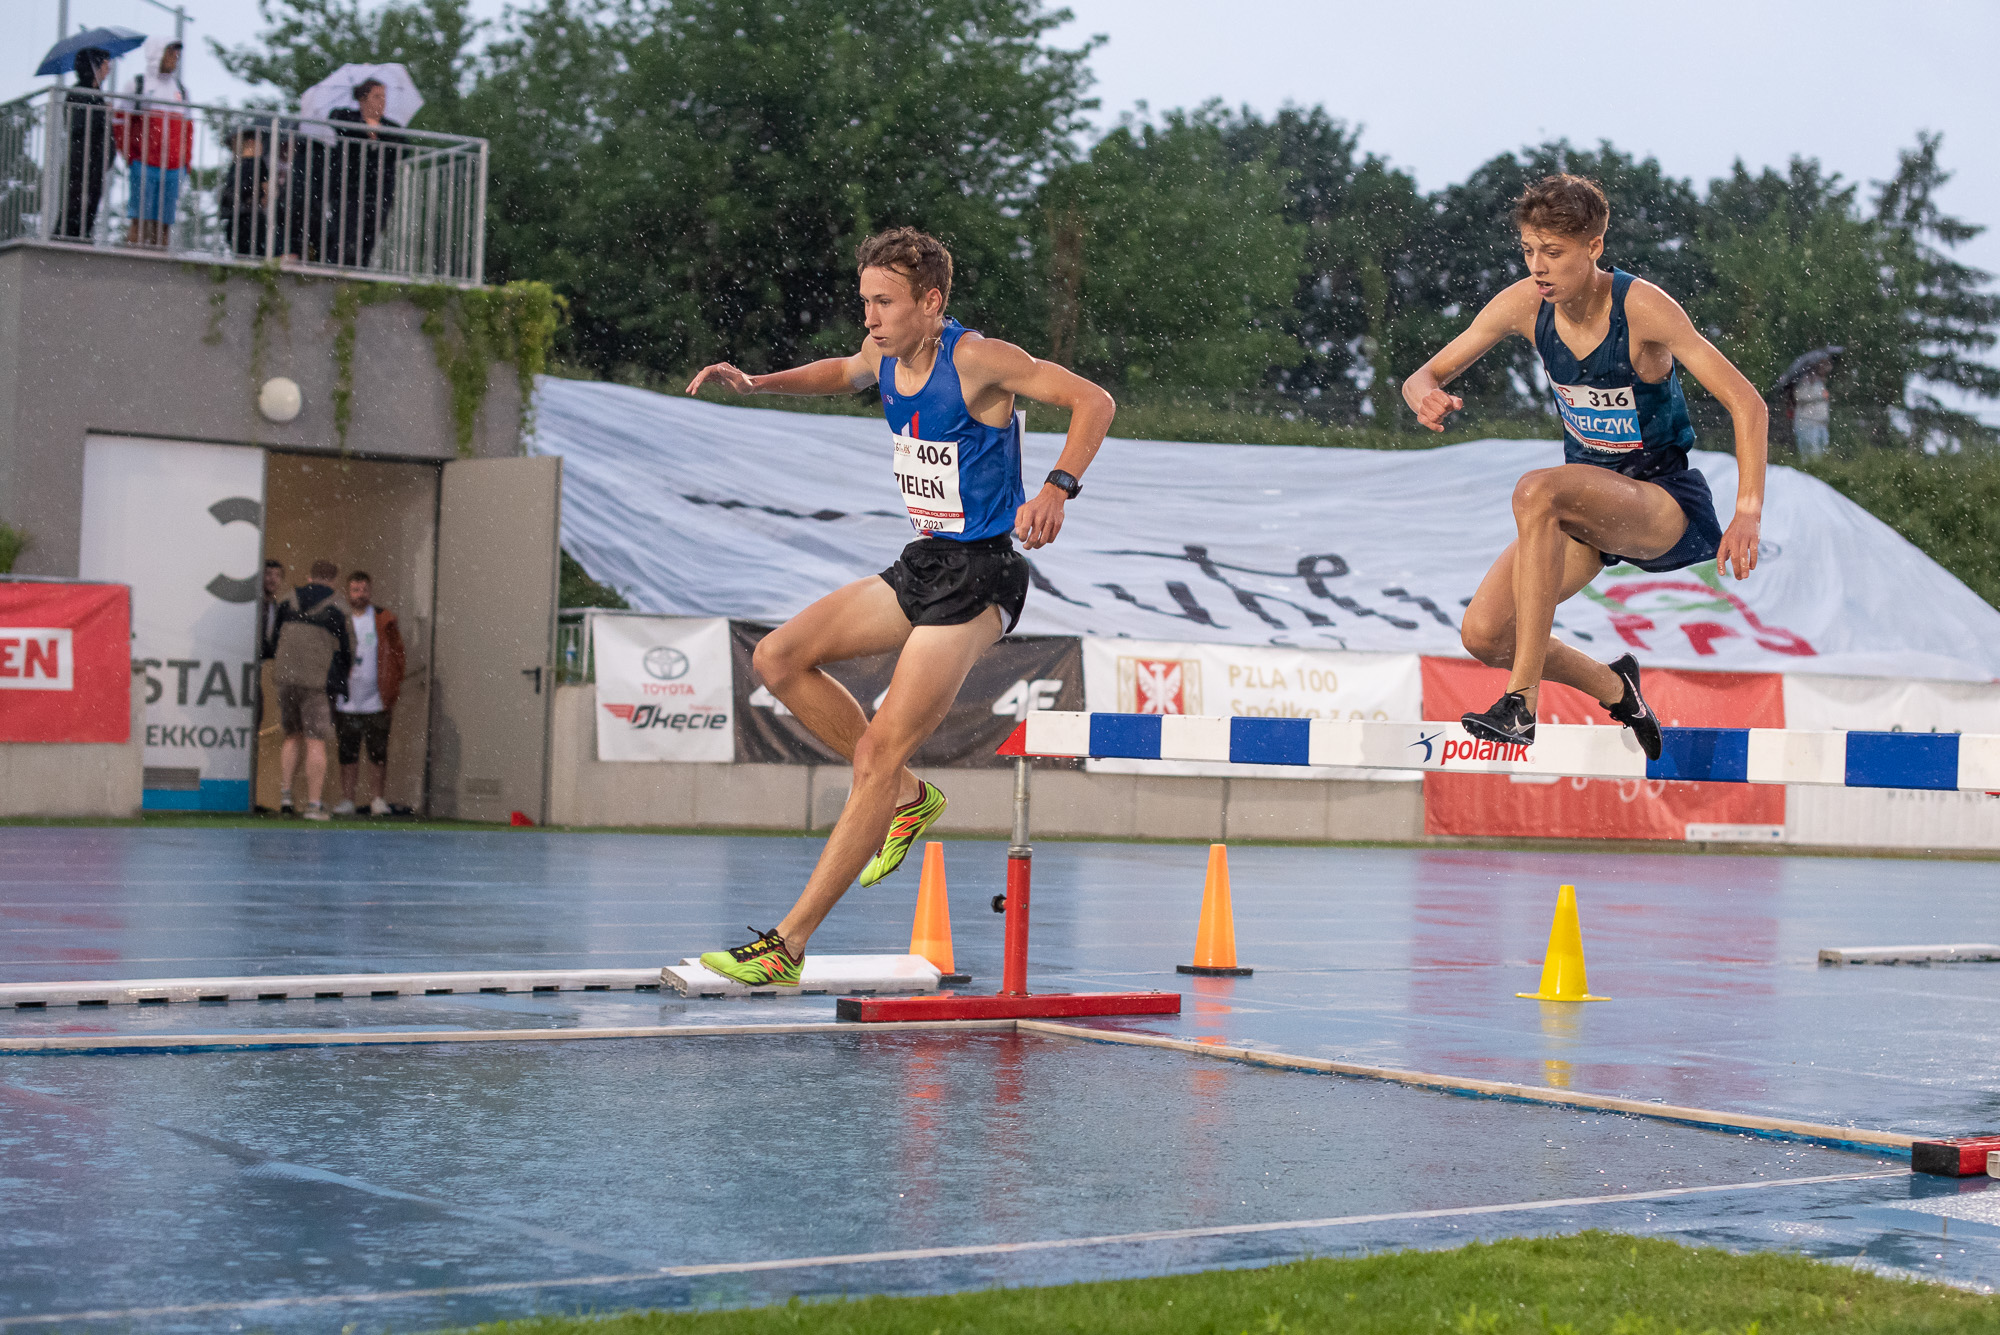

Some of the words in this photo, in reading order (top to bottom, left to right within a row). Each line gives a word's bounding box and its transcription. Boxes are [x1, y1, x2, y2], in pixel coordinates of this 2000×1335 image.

[1588, 391, 1628, 407] 316
[916, 444, 951, 466] 406
[642, 683, 695, 695] TOYOTA
[1228, 664, 1288, 689] PZLA
[1296, 668, 1338, 692] 100
[991, 680, 1062, 721] 4F
[631, 704, 727, 732] Okęcie
[1441, 738, 1529, 766] polanik
